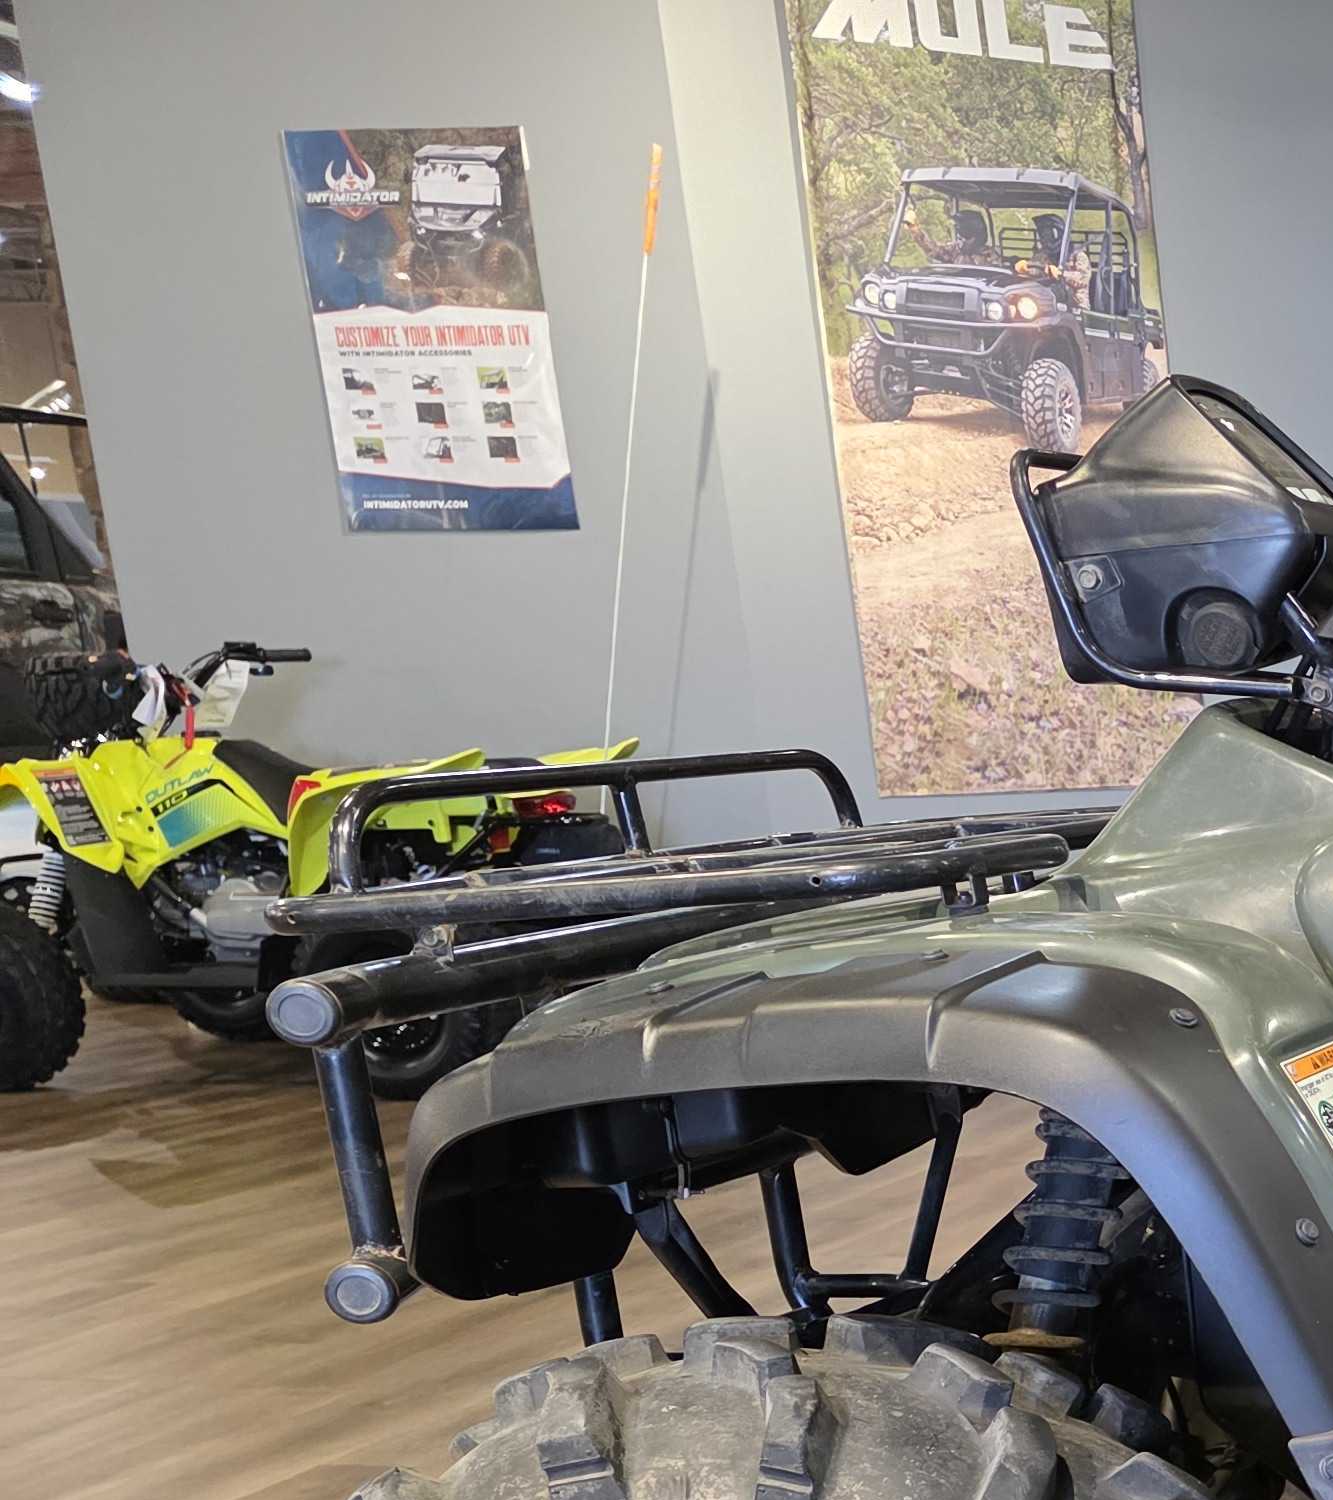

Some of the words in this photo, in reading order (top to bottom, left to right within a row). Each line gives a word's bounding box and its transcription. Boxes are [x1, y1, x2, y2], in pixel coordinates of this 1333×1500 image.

[811, 0, 1115, 71] MULE
[306, 191, 400, 203] INTIMIDATOR
[335, 326, 399, 347] CUSTOMIZE
[402, 325, 433, 347] YOUR
[435, 324, 505, 347] INTIMIDATOR
[508, 324, 530, 346] UTV
[146, 762, 214, 804] OUTLAW
